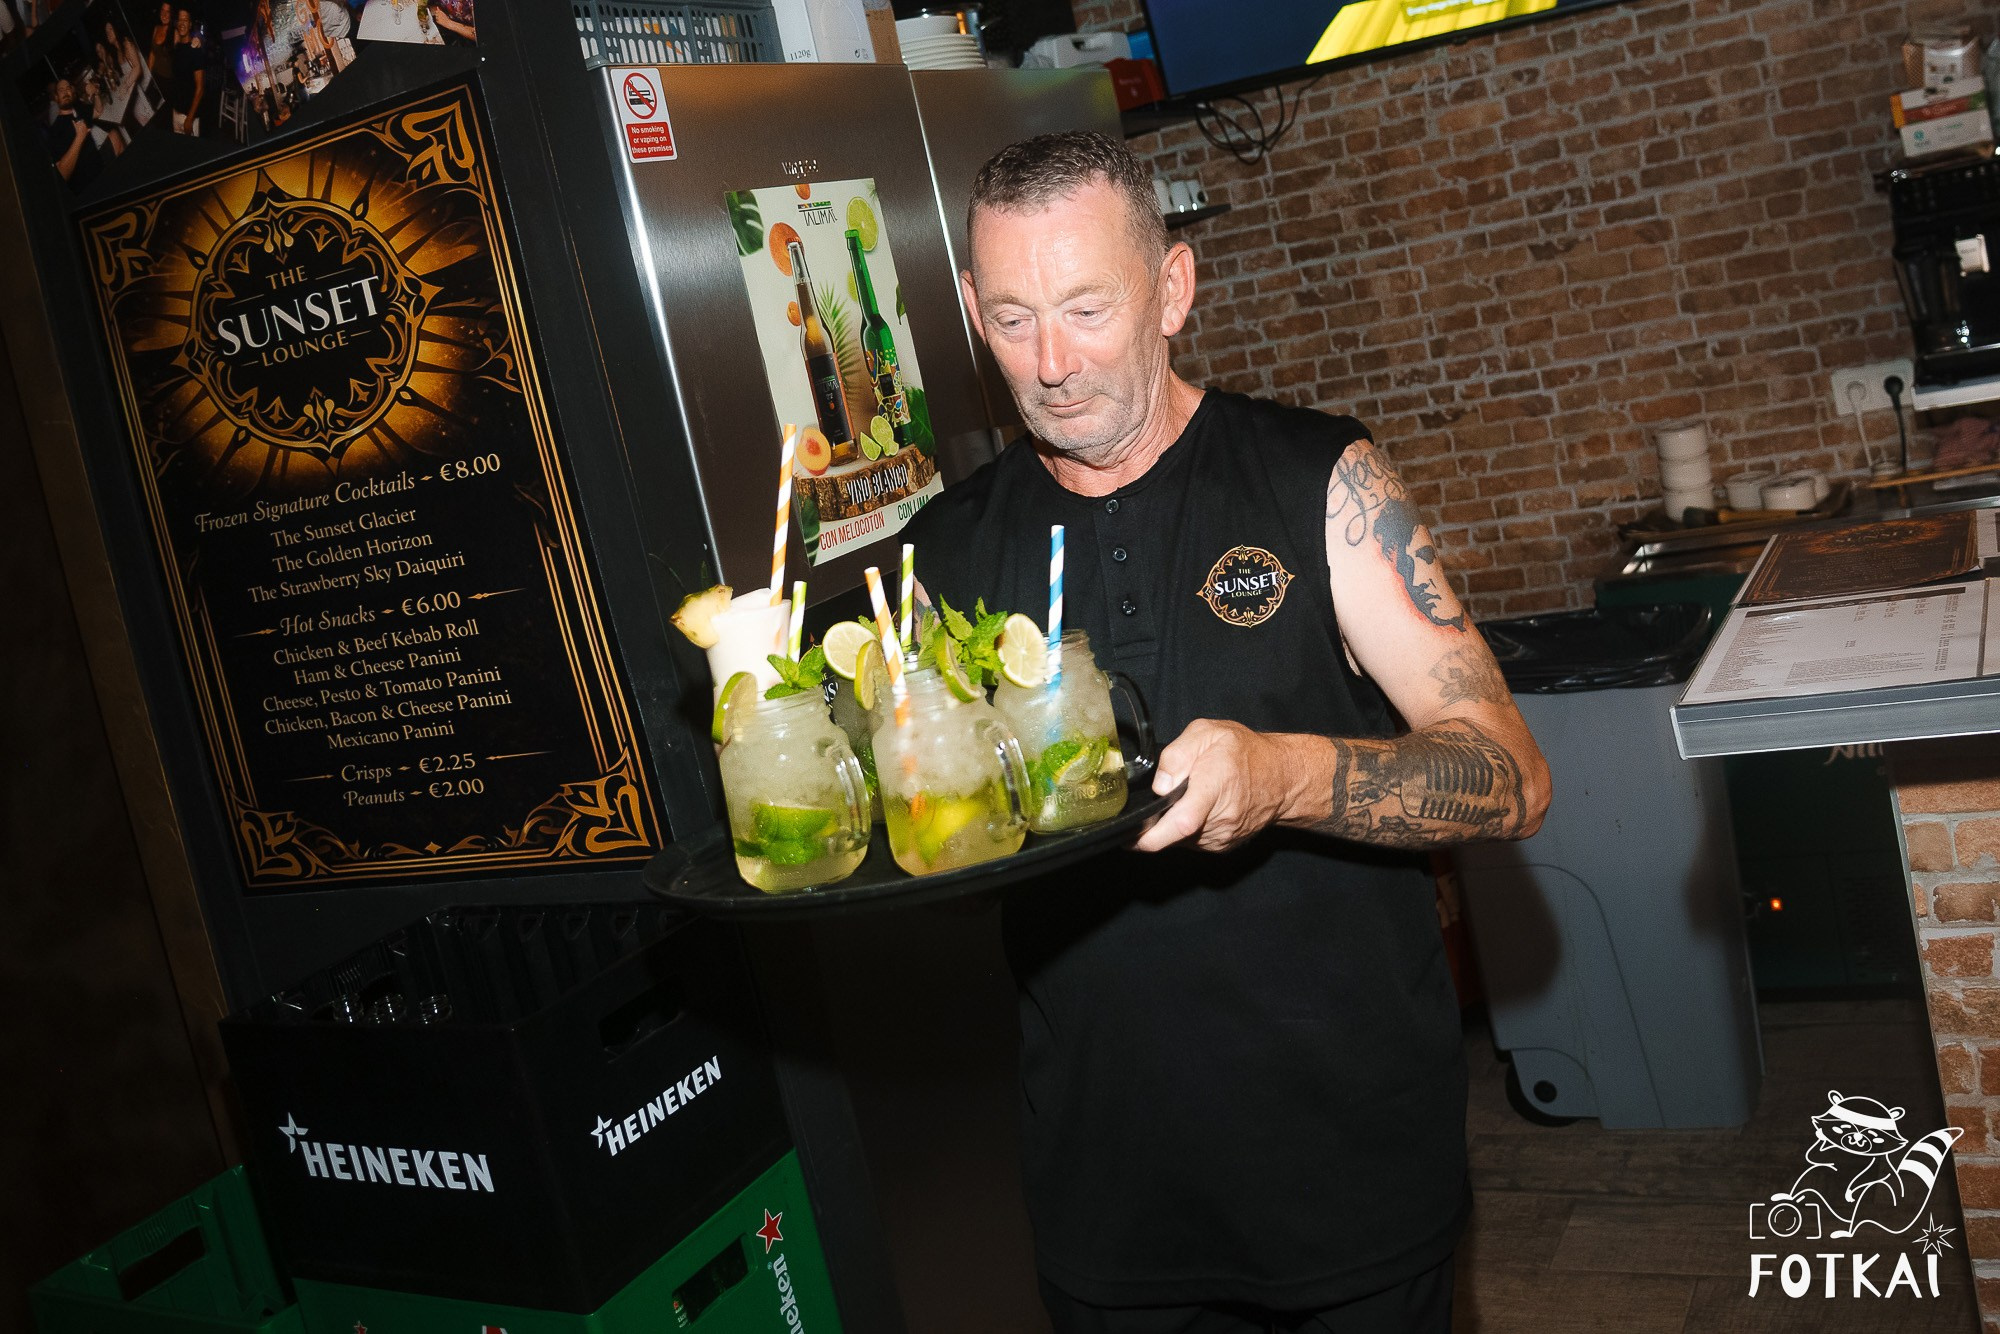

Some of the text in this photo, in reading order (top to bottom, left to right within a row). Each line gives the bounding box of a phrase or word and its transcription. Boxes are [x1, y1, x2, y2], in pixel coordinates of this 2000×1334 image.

[790, 49, 811, 60] 1120g
[632, 145, 672, 154] these premises
[640, 126, 664, 134] smoking
[640, 136, 659, 144] vaping
[266, 265, 308, 290] THE
[217, 275, 379, 356] SUNSET
[262, 329, 349, 367] LOUNGE
[194, 453, 501, 533] Frozen Signature Cocktails €8.00
[847, 463, 908, 505] VINO BLANCO
[270, 507, 417, 548] The Sunset Glacier
[820, 509, 885, 550] CON MELOCOTÓN
[897, 501, 913, 521] CON
[272, 532, 433, 574] The Golden Horizon
[248, 550, 467, 604] The Strawberry Sky Daiquiri
[1214, 571, 1279, 596] SUNSET
[1231, 589, 1263, 598] LOUNGE
[280, 590, 461, 636] Hot Snacks €6.00
[273, 618, 481, 666] Chicken & Beef Kebab Roll
[294, 646, 462, 686] Ham & Cheese Panini
[263, 665, 502, 713] Cheese, Pesto & Tomato Panini
[264, 689, 513, 736] Chicken, Bacon & Cheese Panini
[327, 719, 455, 750] Mexicano Panini
[341, 752, 477, 784] Crisps €2.25
[342, 777, 485, 808] Peanuts €2.00
[604, 1054, 723, 1157] HEINEKEN
[301, 1139, 495, 1193] HEINEKEN
